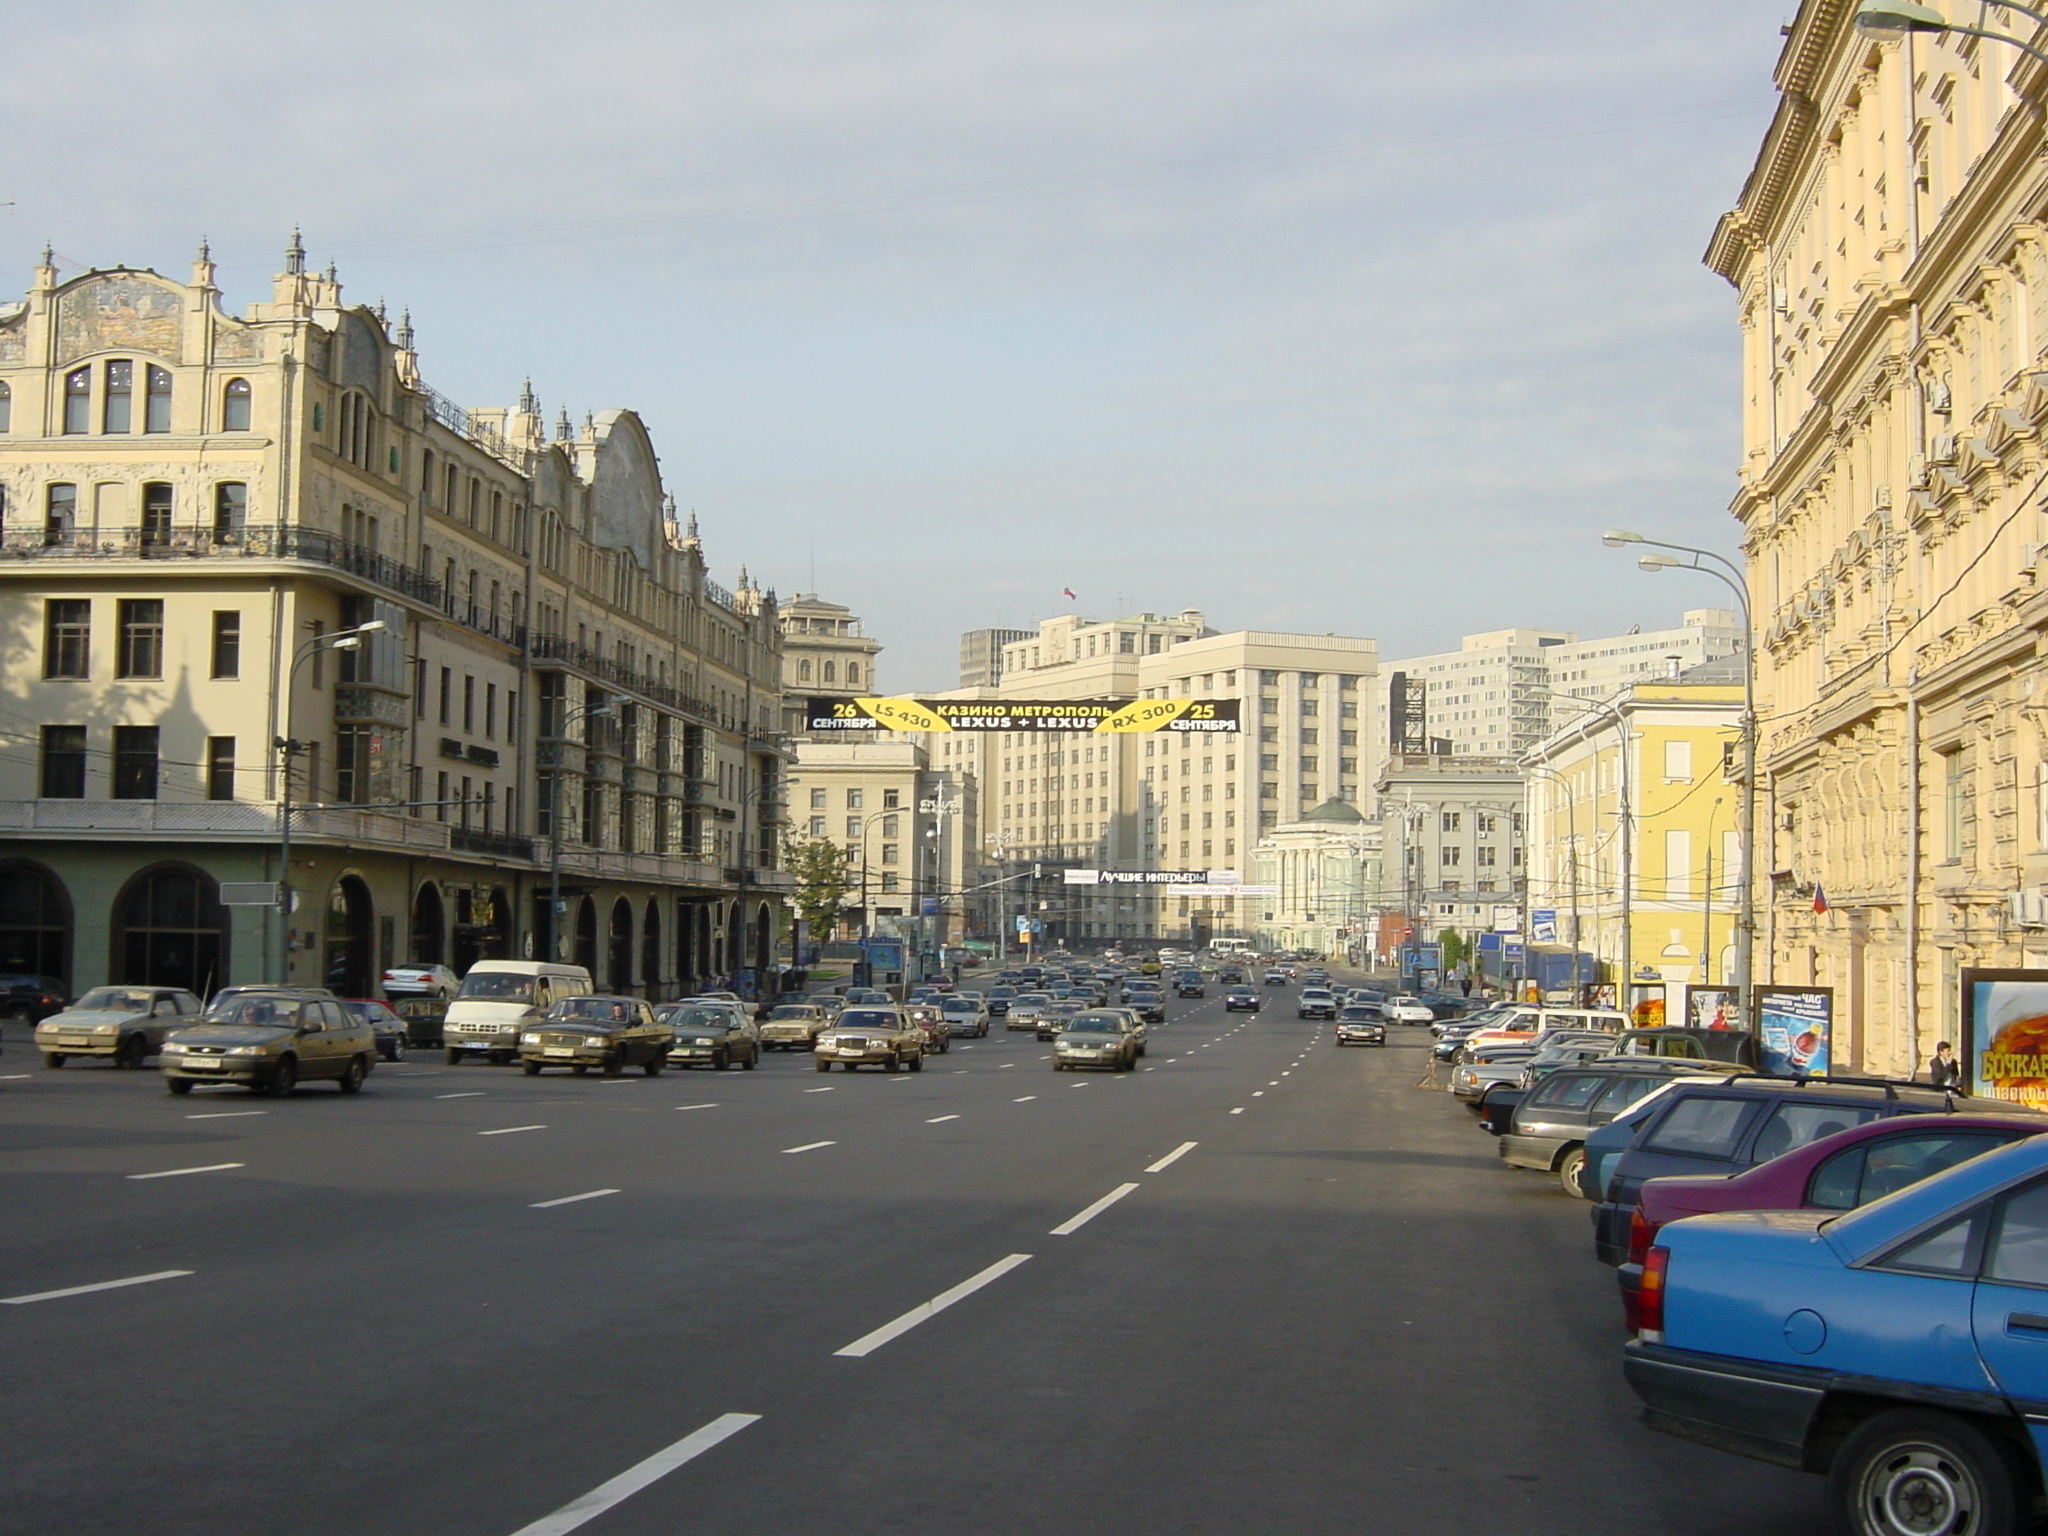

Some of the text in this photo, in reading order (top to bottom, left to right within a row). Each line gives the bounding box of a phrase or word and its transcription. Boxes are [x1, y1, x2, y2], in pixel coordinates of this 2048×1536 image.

[833, 704, 857, 718] 26
[874, 703, 931, 729] LS 430
[936, 706, 1113, 718] КАЗИНО МЕТРОПОЛЬ
[1111, 703, 1176, 729] RX 300
[1190, 704, 1215, 719] 25
[812, 717, 877, 729] СЕНТЯБРЯ
[951, 717, 1012, 728] LEXUS
[1036, 718, 1098, 729] LEXUS
[1169, 719, 1237, 731] СЕНТЯБРЯ
